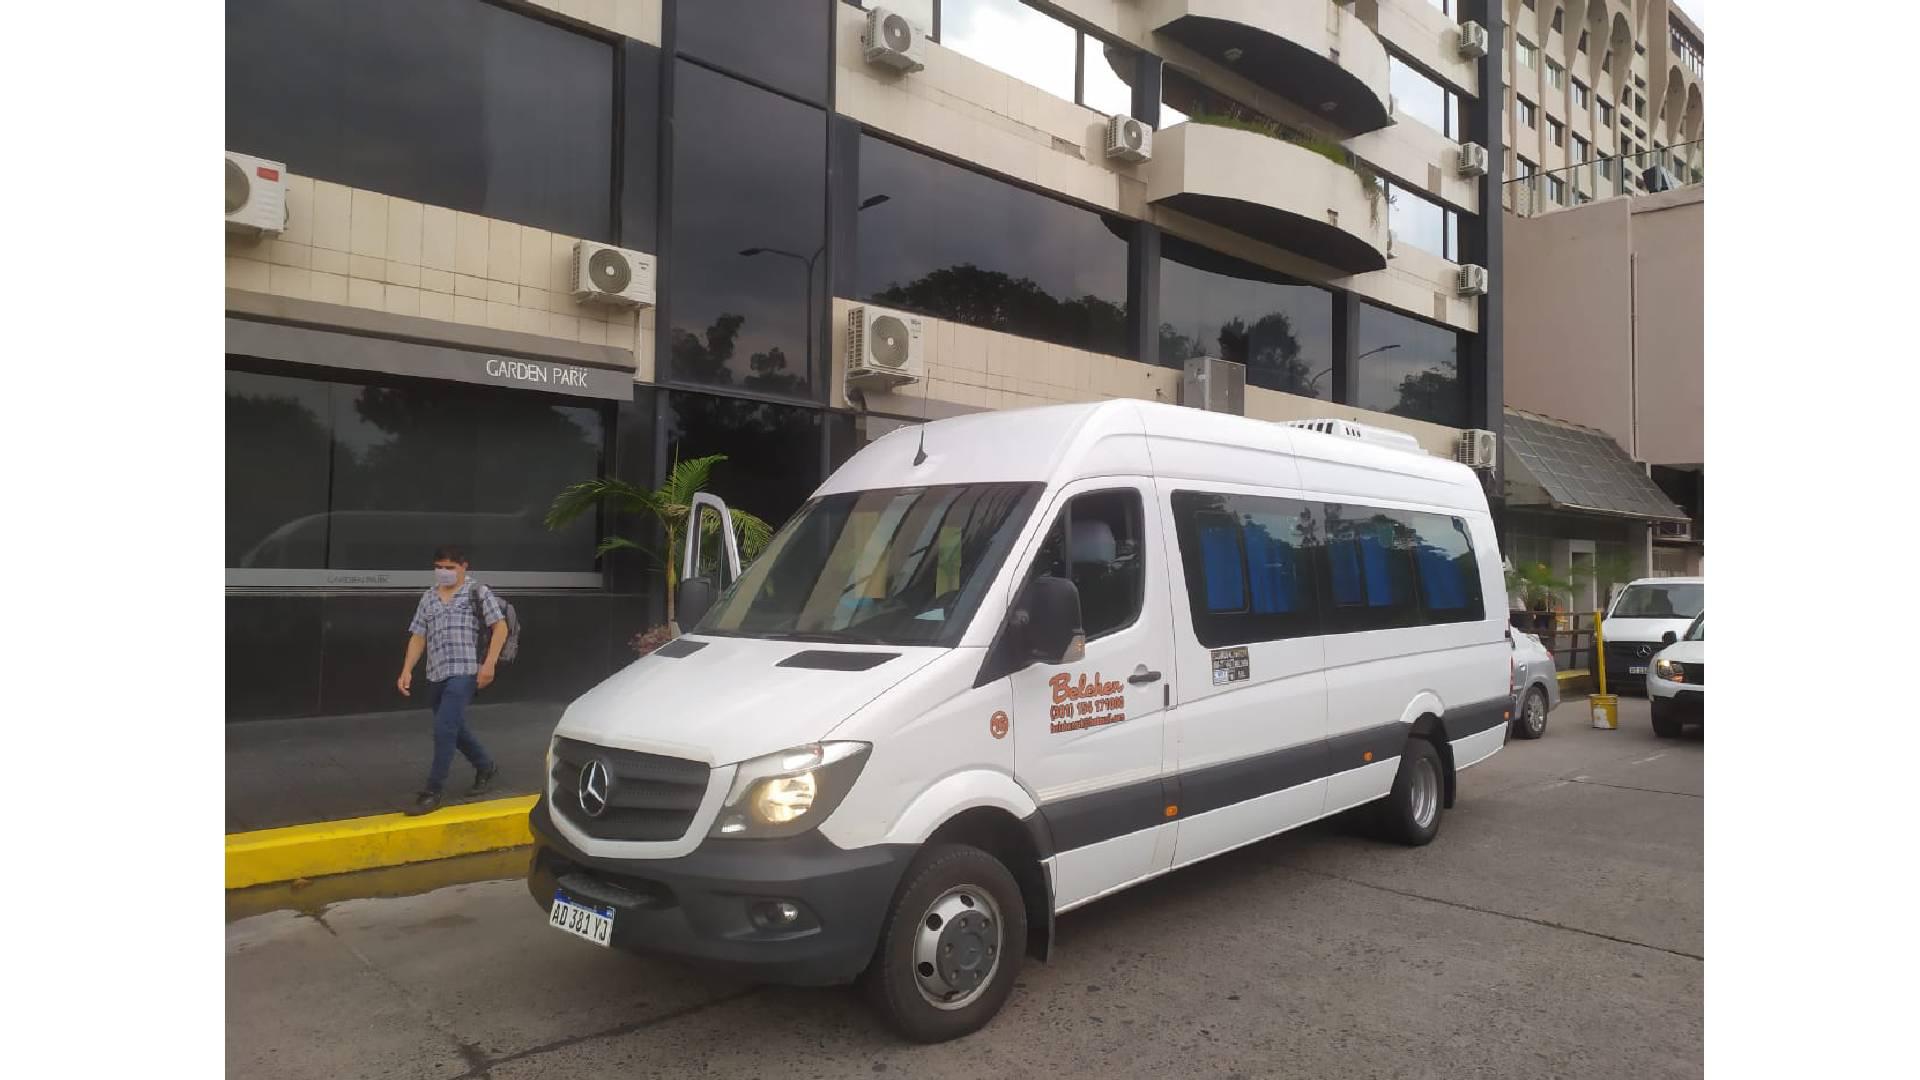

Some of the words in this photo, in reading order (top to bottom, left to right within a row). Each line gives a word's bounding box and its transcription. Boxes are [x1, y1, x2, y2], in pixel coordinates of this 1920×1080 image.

[486, 360, 547, 383] GARDEN
[553, 367, 588, 388] PARK
[552, 903, 569, 926] AD
[568, 909, 591, 935] 381
[593, 917, 608, 941] YJ
